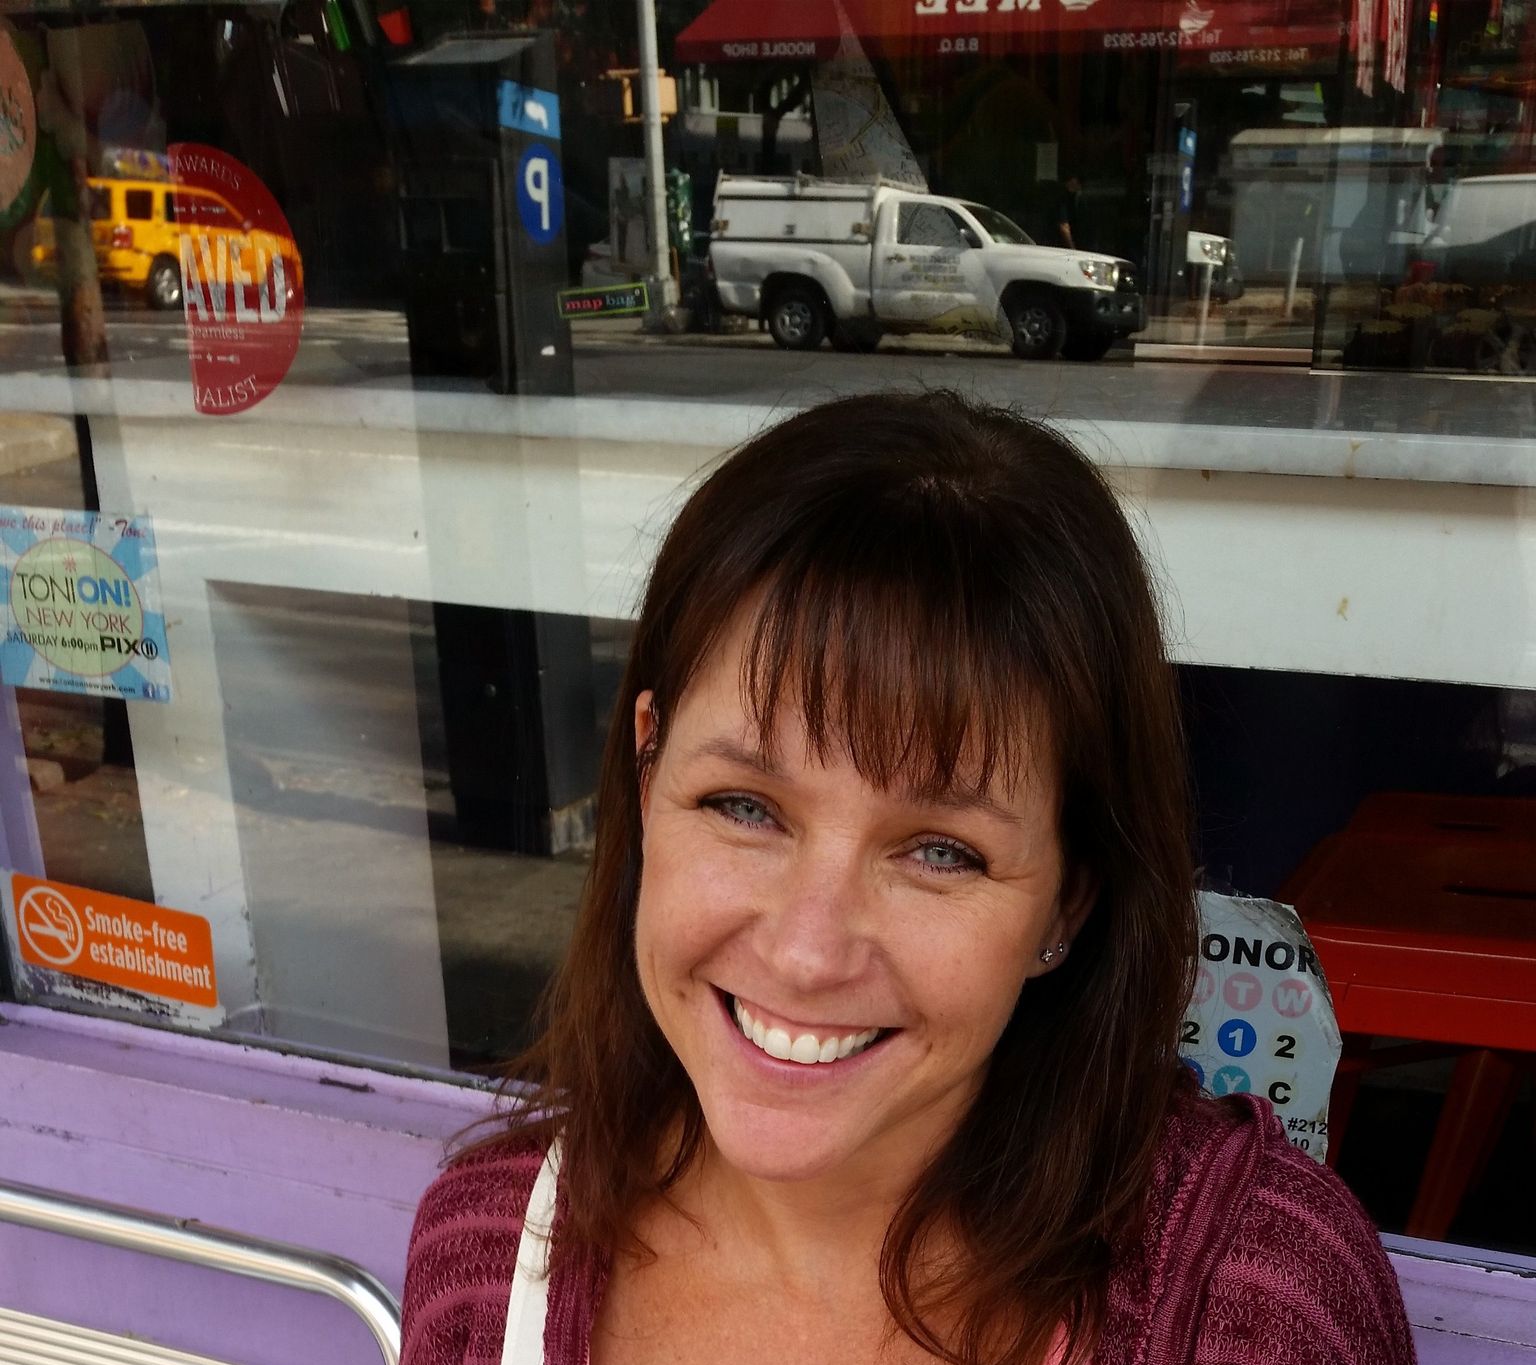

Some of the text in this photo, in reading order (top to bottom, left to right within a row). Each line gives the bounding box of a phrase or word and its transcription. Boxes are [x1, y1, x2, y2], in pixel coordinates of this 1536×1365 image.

[175, 153, 241, 190] AWARDS
[180, 233, 286, 323] AVED
[565, 297, 603, 312] map
[22, 514, 45, 531] this
[26, 608, 132, 634] NEW YORK
[7, 631, 58, 647] SATURDAY
[85, 905, 188, 953] Smoke-free
[90, 942, 212, 990] establishment
[1232, 980, 1255, 1006] T
[1276, 987, 1310, 1012] W
[1181, 1021, 1296, 1058] 2 1 2
[1221, 1072, 1291, 1104] Y C
[1287, 1117, 1327, 1135] #212
